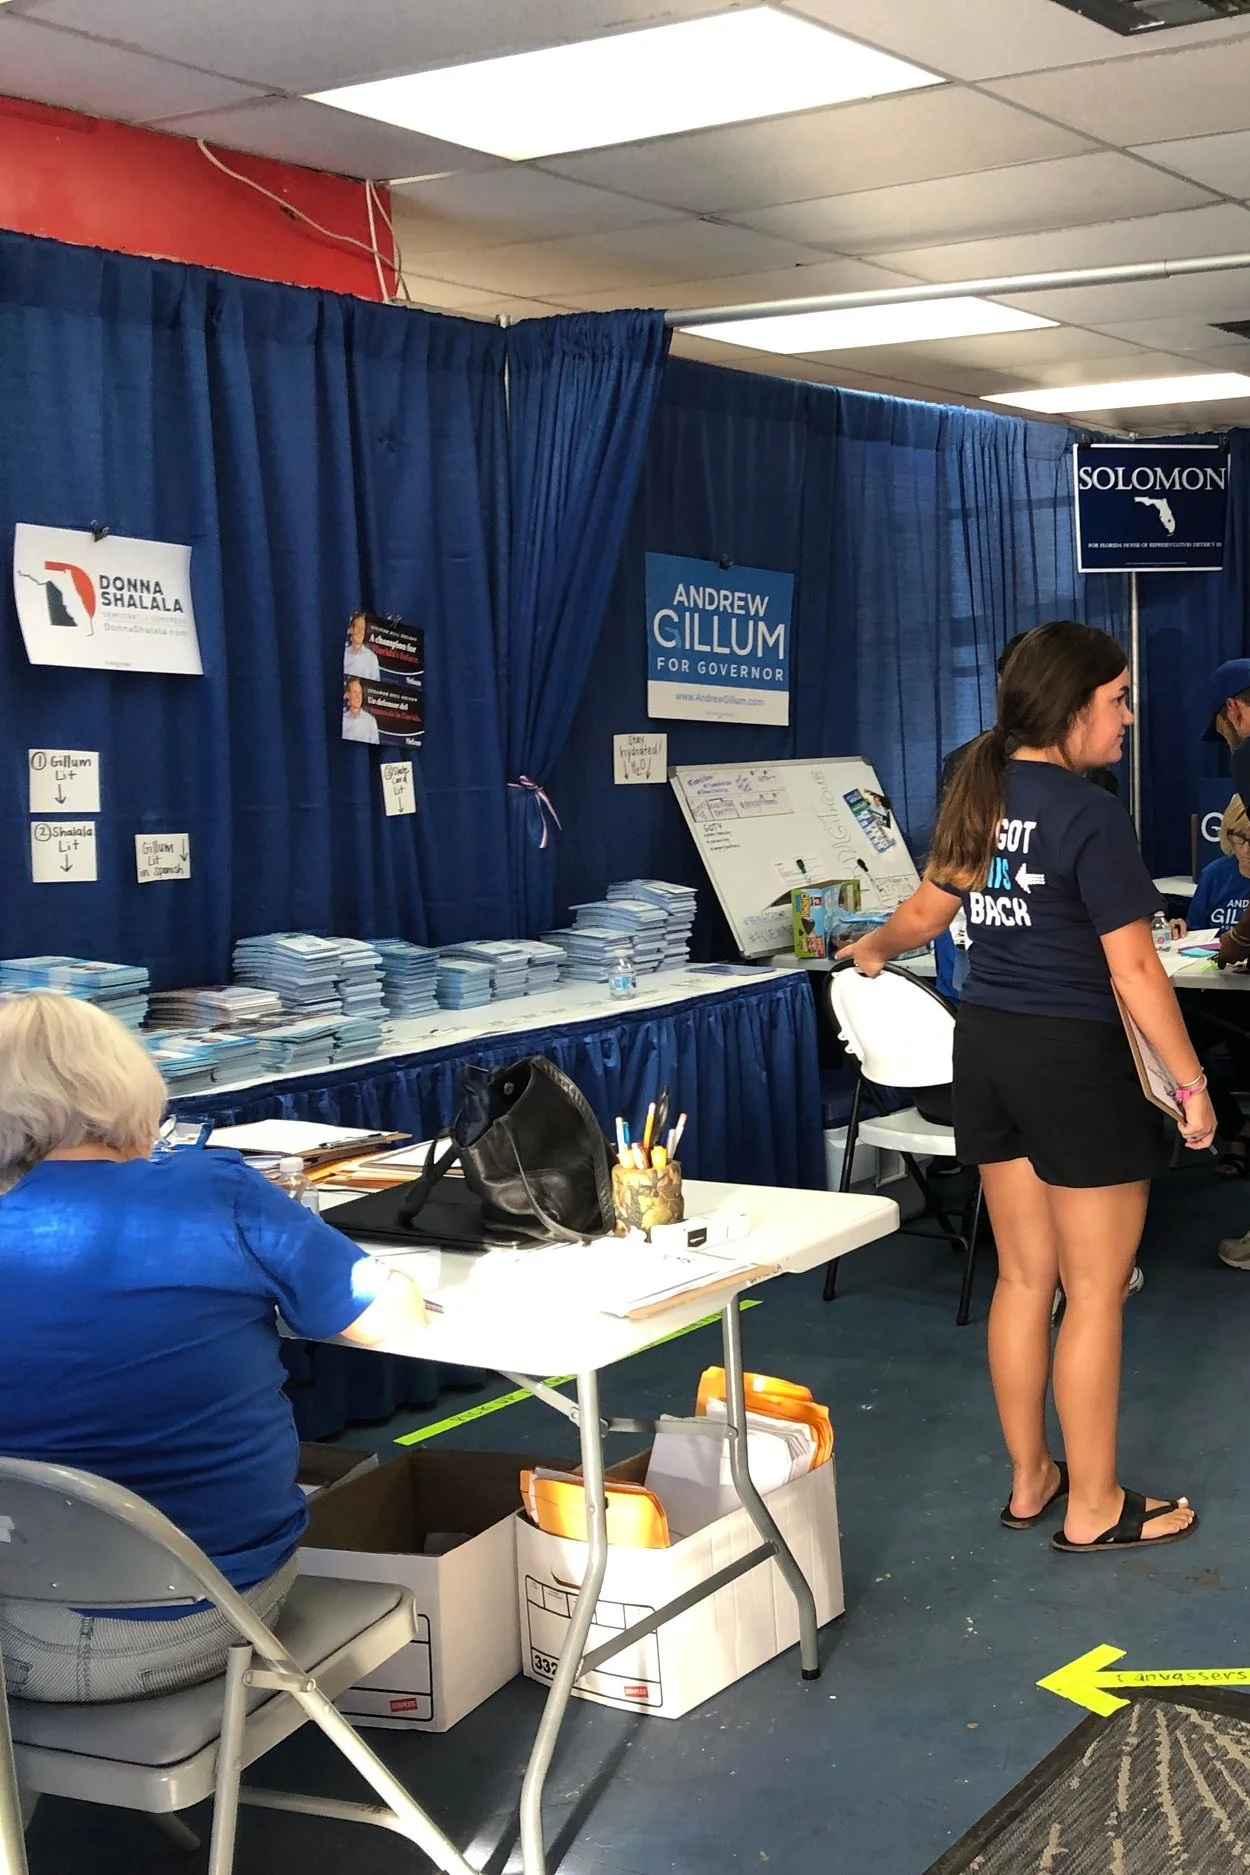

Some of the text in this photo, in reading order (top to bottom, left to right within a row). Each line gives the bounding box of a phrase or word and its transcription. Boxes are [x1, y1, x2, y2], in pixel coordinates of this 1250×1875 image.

[1079, 466, 1227, 490] SOLOMON
[99, 574, 164, 596] DONNA
[101, 591, 184, 613] SHALALA
[673, 583, 769, 617] ANDREW
[653, 608, 785, 660] GILLUM
[656, 657, 784, 681] FOR GOVERNOR
[628, 735, 644, 746] Stay
[619, 741, 662, 759] hydrated!
[50, 755, 91, 768] Gillum
[55, 770, 77, 781] Lit
[51, 827, 93, 837] Shalala
[996, 819, 1037, 854] GOT
[59, 839, 80, 852] Lit
[142, 840, 174, 854] Gillum
[148, 856, 161, 866] Lit
[140, 868, 150, 877] in
[970, 891, 1032, 926] BACK
